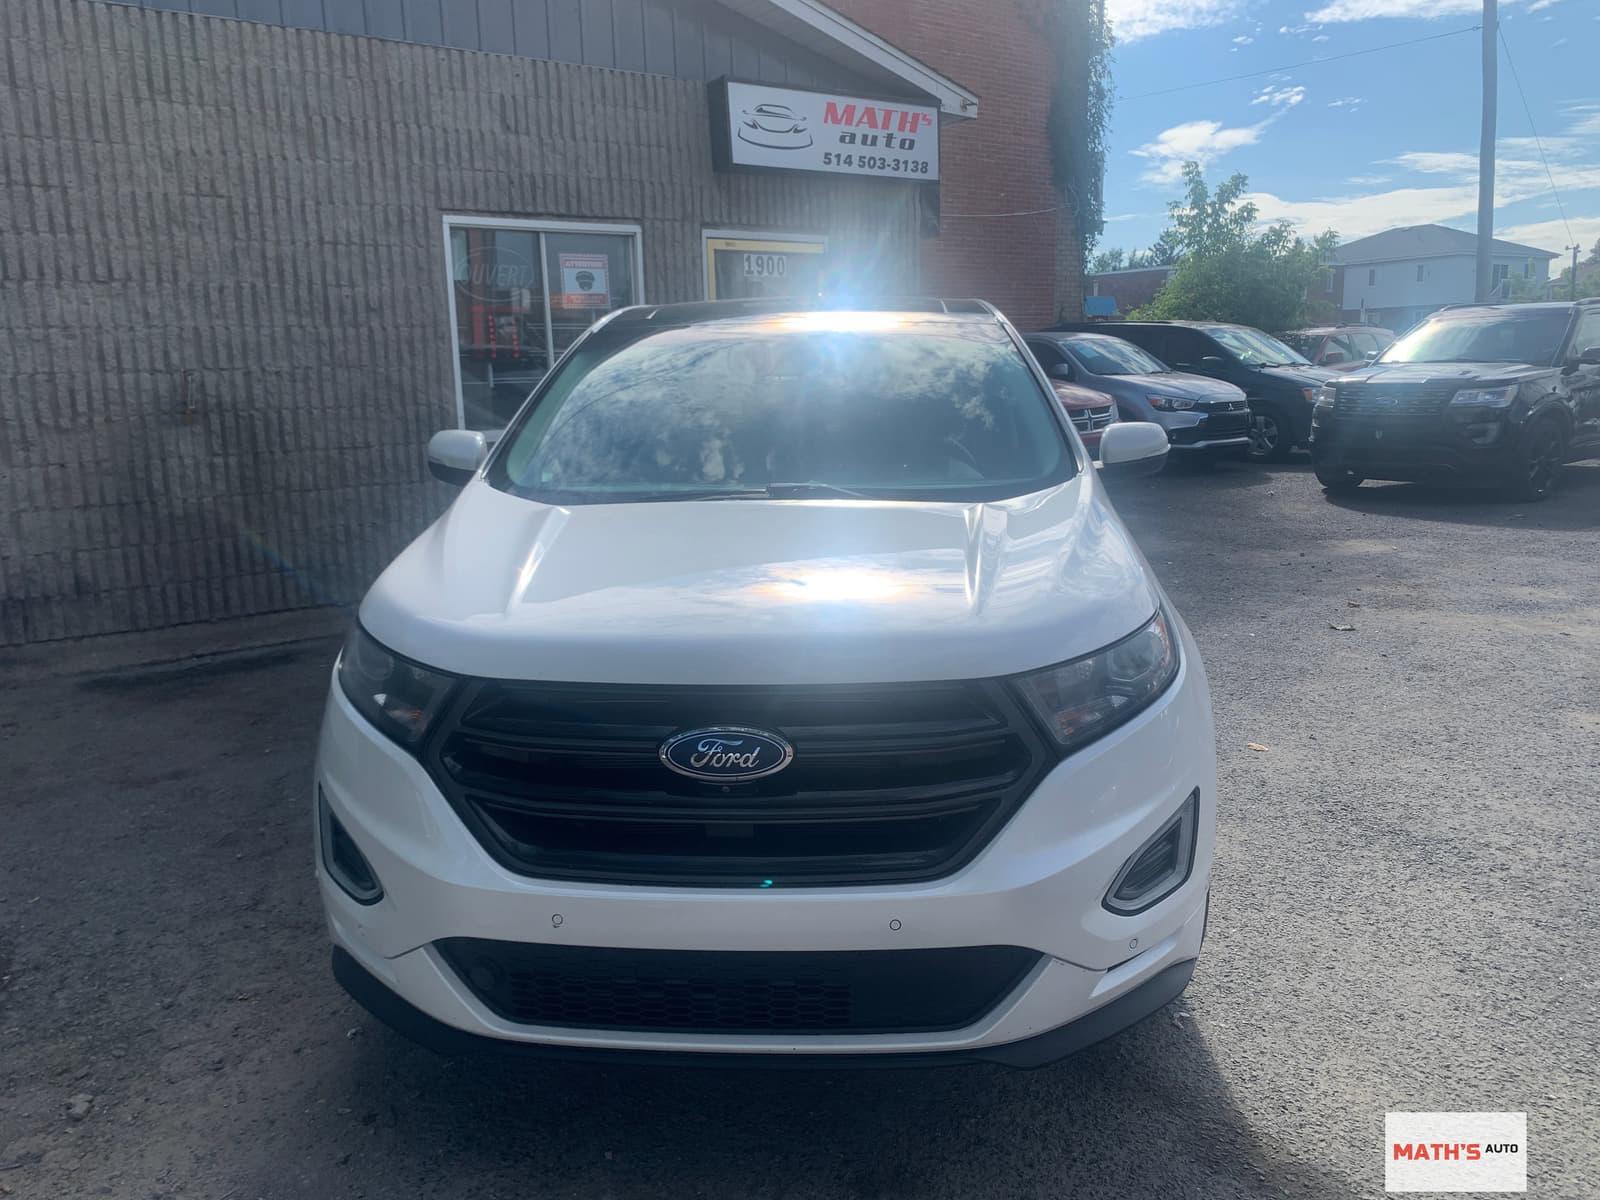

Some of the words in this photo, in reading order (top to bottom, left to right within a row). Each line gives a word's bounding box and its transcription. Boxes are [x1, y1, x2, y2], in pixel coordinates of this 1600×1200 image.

[839, 131, 915, 150] auto
[823, 152, 853, 167] 514
[858, 155, 929, 174] 503-3138
[744, 255, 785, 275] 1900
[690, 738, 761, 768] Ford
